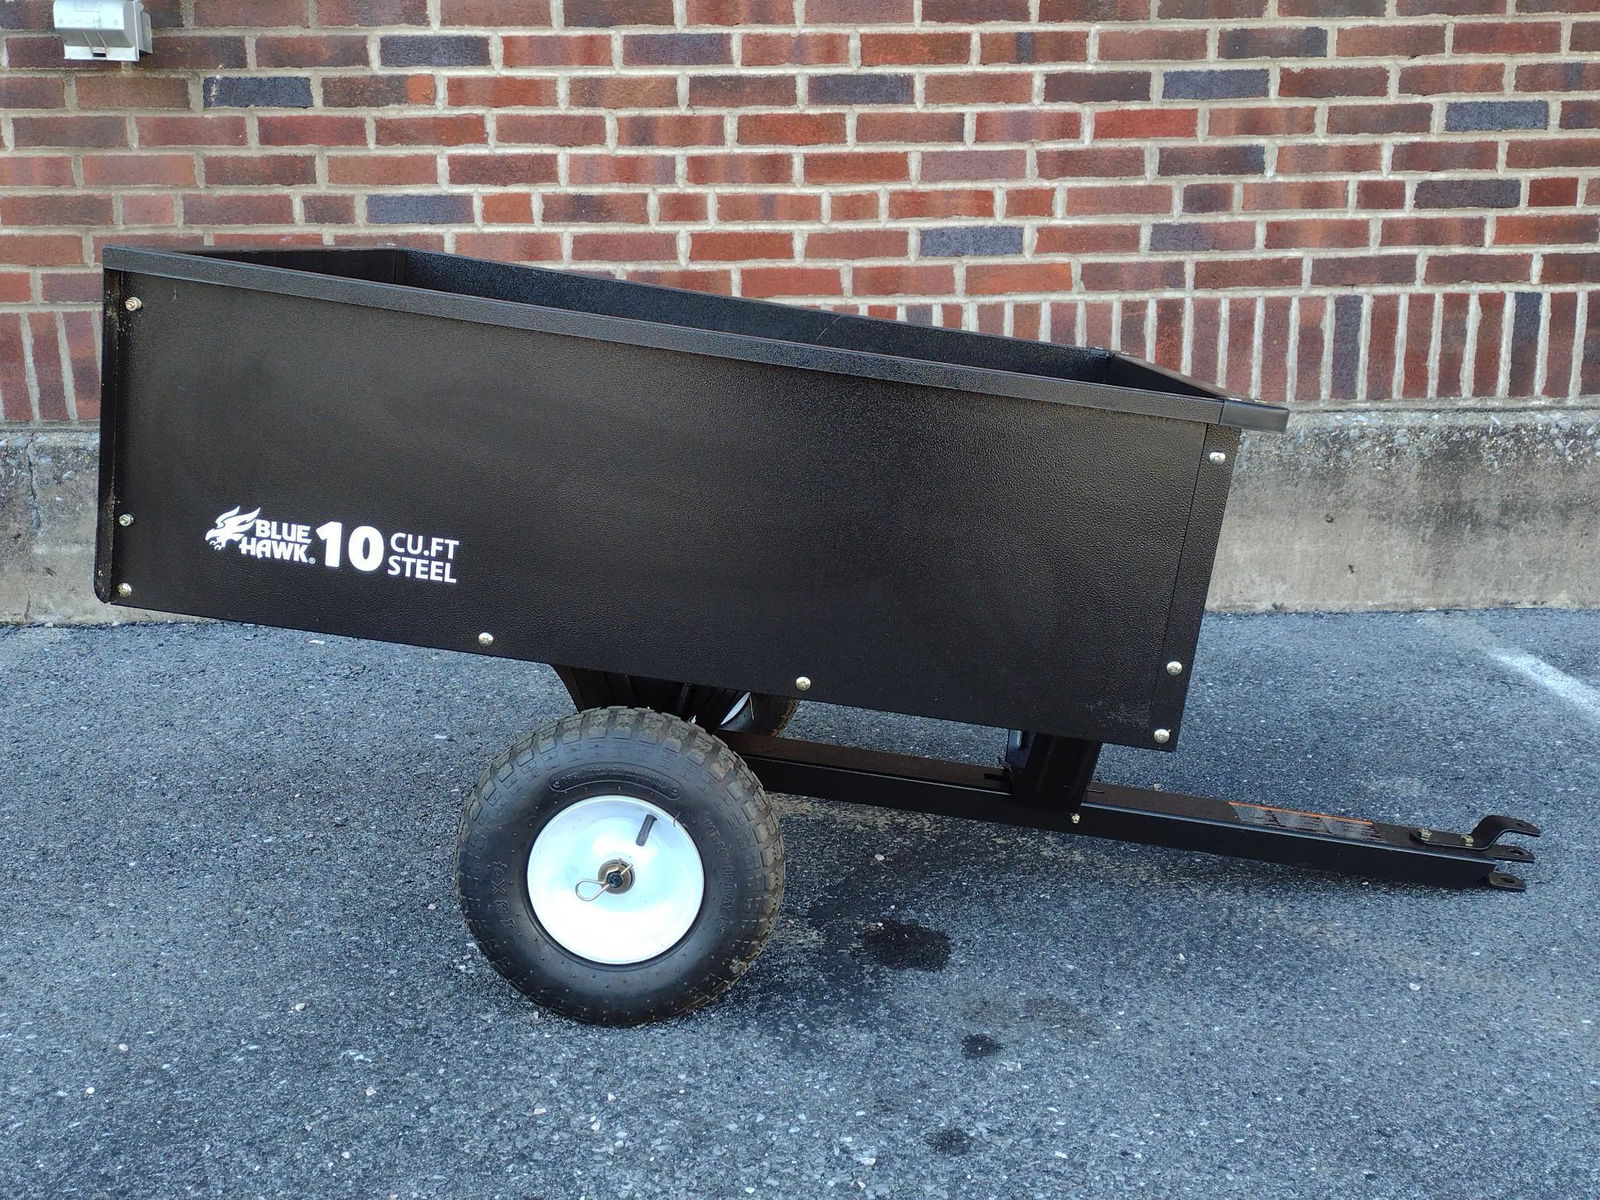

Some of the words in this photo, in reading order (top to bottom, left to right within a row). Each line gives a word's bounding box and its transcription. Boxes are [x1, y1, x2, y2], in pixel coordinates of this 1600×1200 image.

[255, 519, 312, 544] BLUE
[316, 521, 385, 571] 10
[390, 532, 460, 559] CU.FT
[387, 555, 457, 583] STEEL
